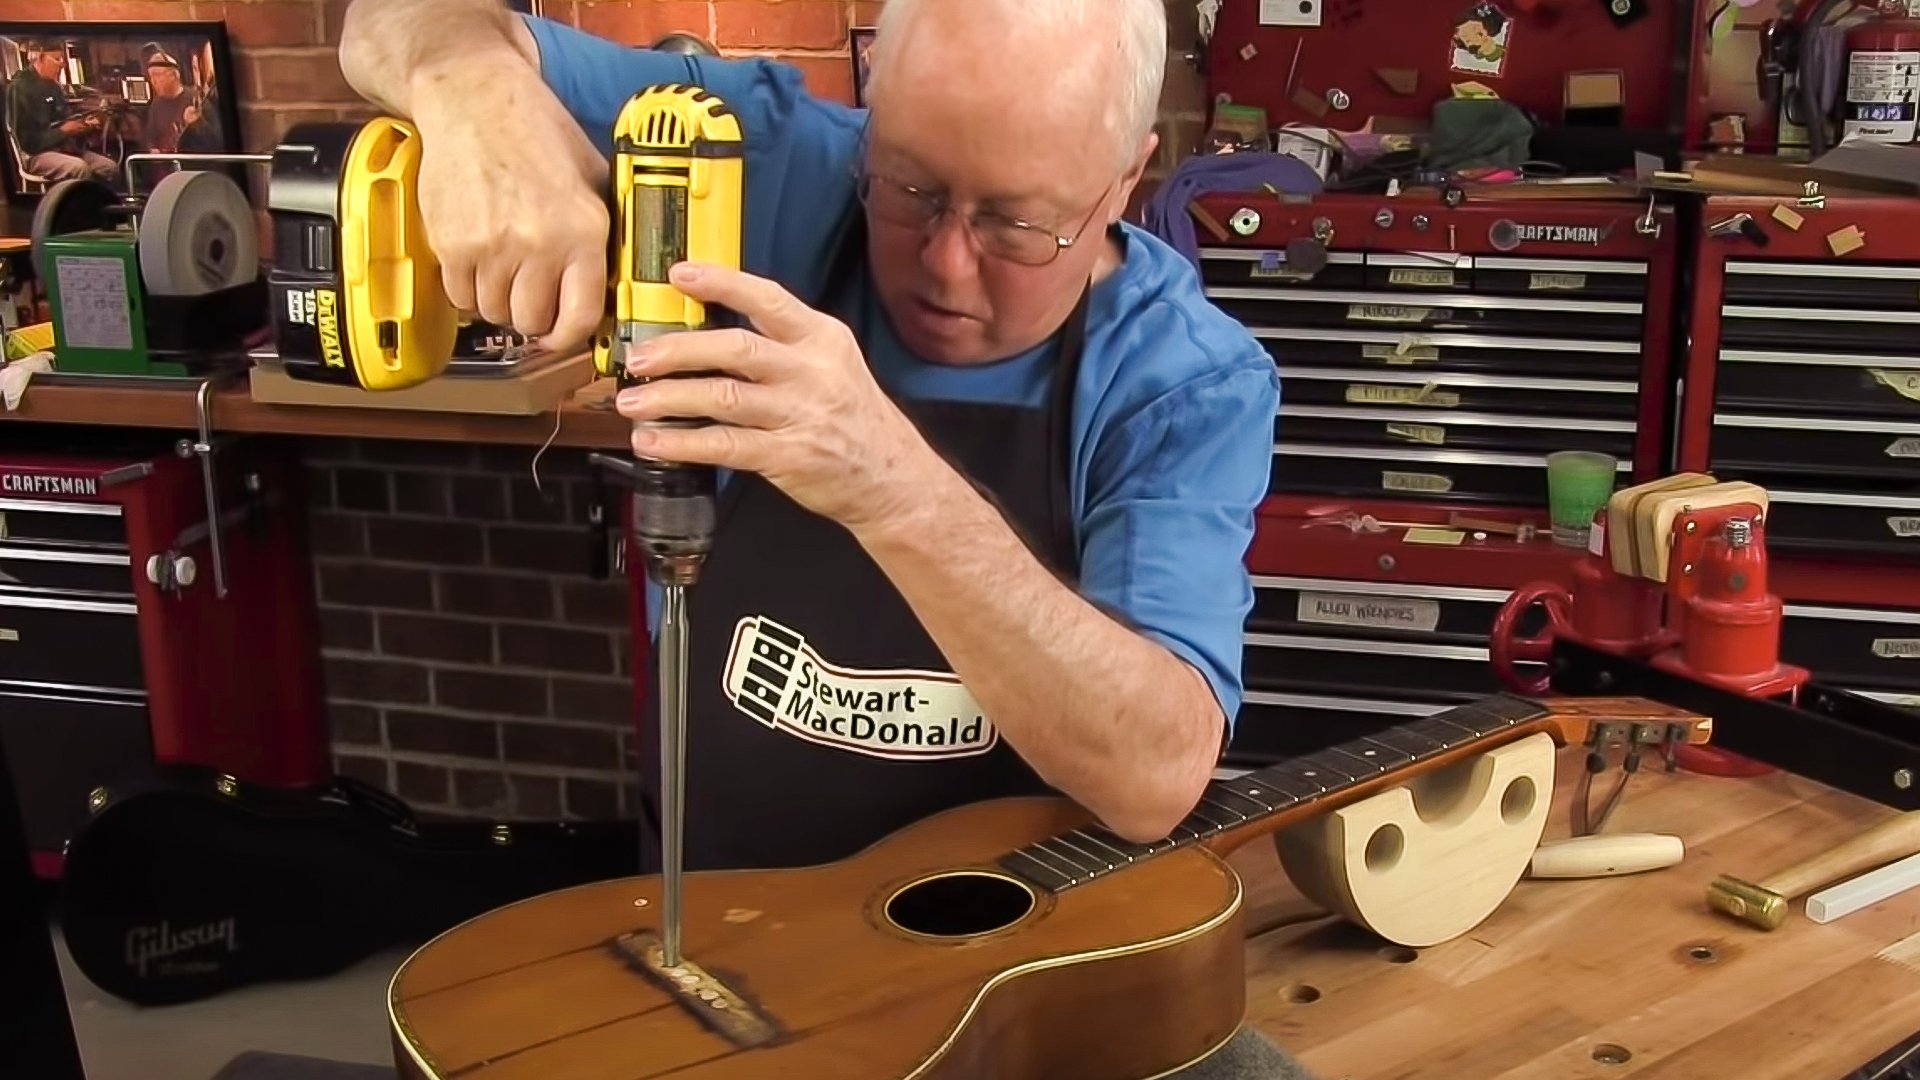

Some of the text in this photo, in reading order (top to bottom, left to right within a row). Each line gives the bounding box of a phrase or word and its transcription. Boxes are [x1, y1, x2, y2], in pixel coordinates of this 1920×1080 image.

[1515, 224, 1599, 242] RAFTSMAN
[3, 474, 97, 495] CRAFTSMAN
[1316, 599, 1350, 616] ALLEN
[796, 660, 930, 713] Stewart-
[785, 690, 983, 746] MacDonald
[126, 917, 240, 977] Gibson
